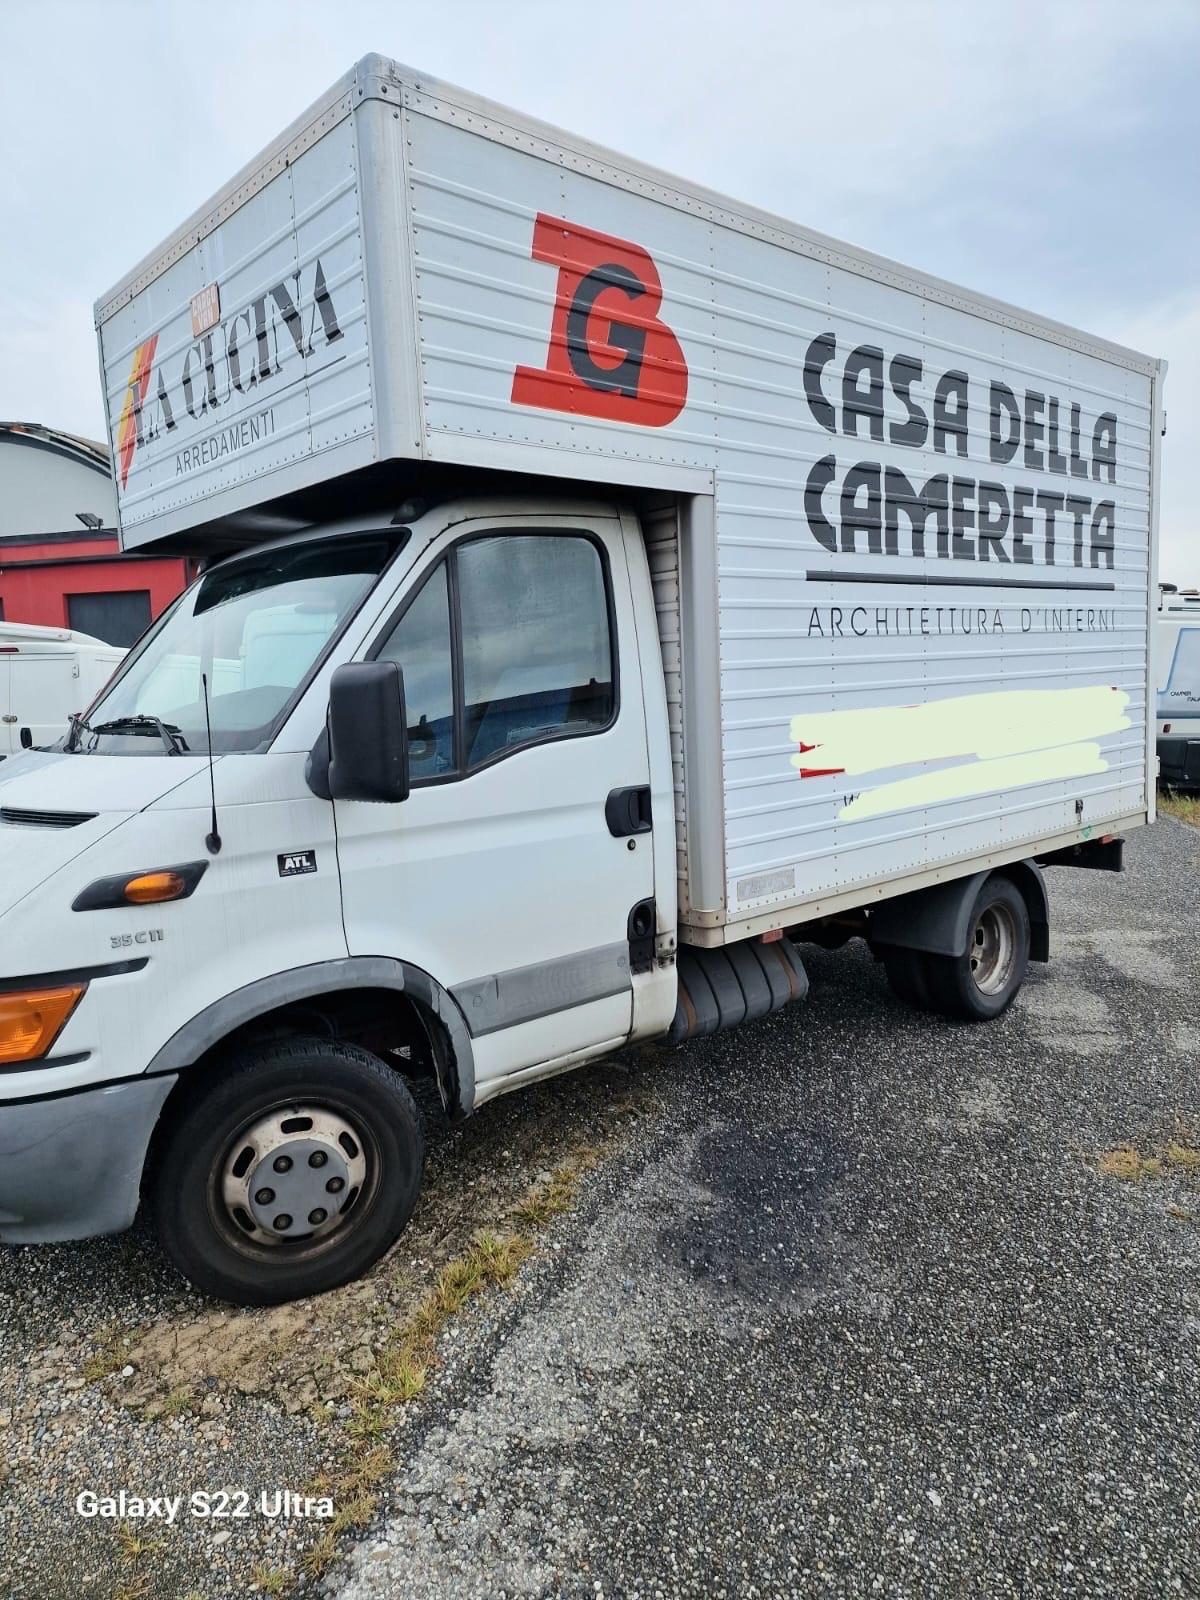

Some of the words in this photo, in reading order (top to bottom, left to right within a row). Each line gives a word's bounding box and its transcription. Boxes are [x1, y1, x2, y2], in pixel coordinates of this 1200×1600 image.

[130, 367, 178, 450] LA
[181, 258, 345, 420] CUCINA
[176, 408, 275, 476] ARREDAMENTI
[803, 332, 969, 458] CASA
[989, 379, 1118, 484] DELLA
[803, 453, 1116, 569] CAMERETTA
[807, 606, 1004, 637] ARCHITETTURA
[1020, 607, 1116, 633] D'INTERNI
[284, 855, 311, 870] ATL
